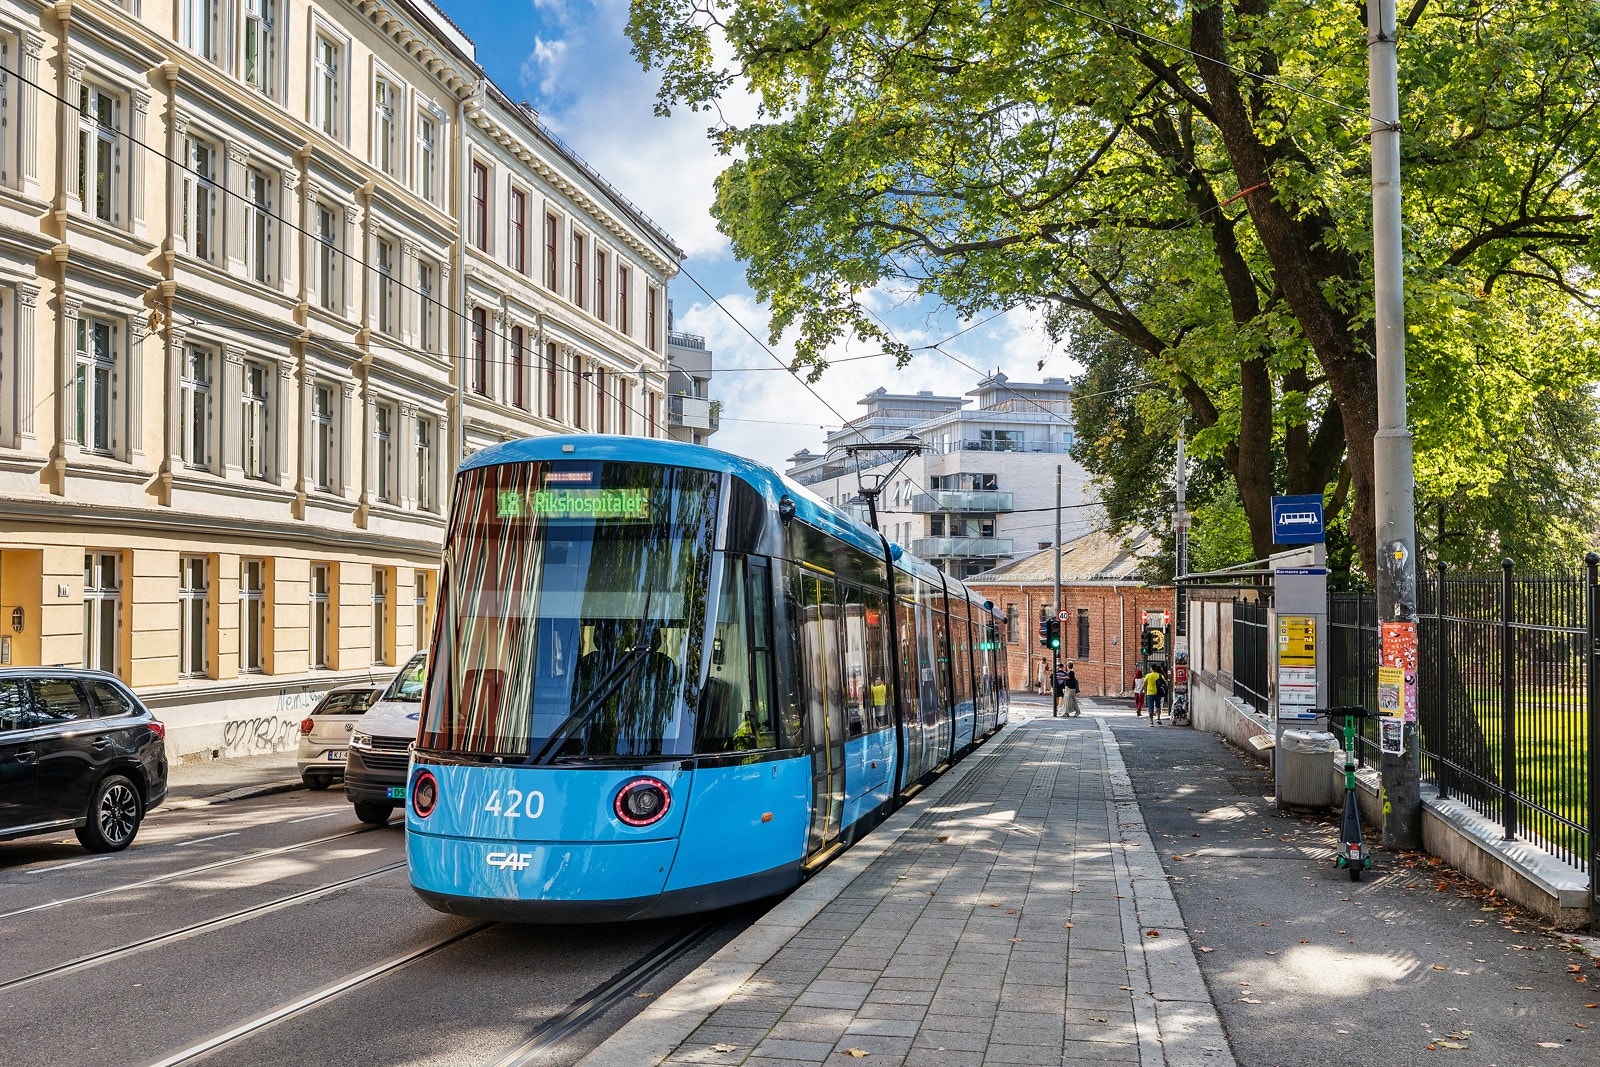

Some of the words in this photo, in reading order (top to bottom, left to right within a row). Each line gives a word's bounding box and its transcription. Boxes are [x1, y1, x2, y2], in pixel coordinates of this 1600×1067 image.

[499, 492, 519, 515] 18
[534, 492, 643, 517] Rikshospitalet
[484, 789, 545, 819] 420
[486, 852, 532, 871] CAF
